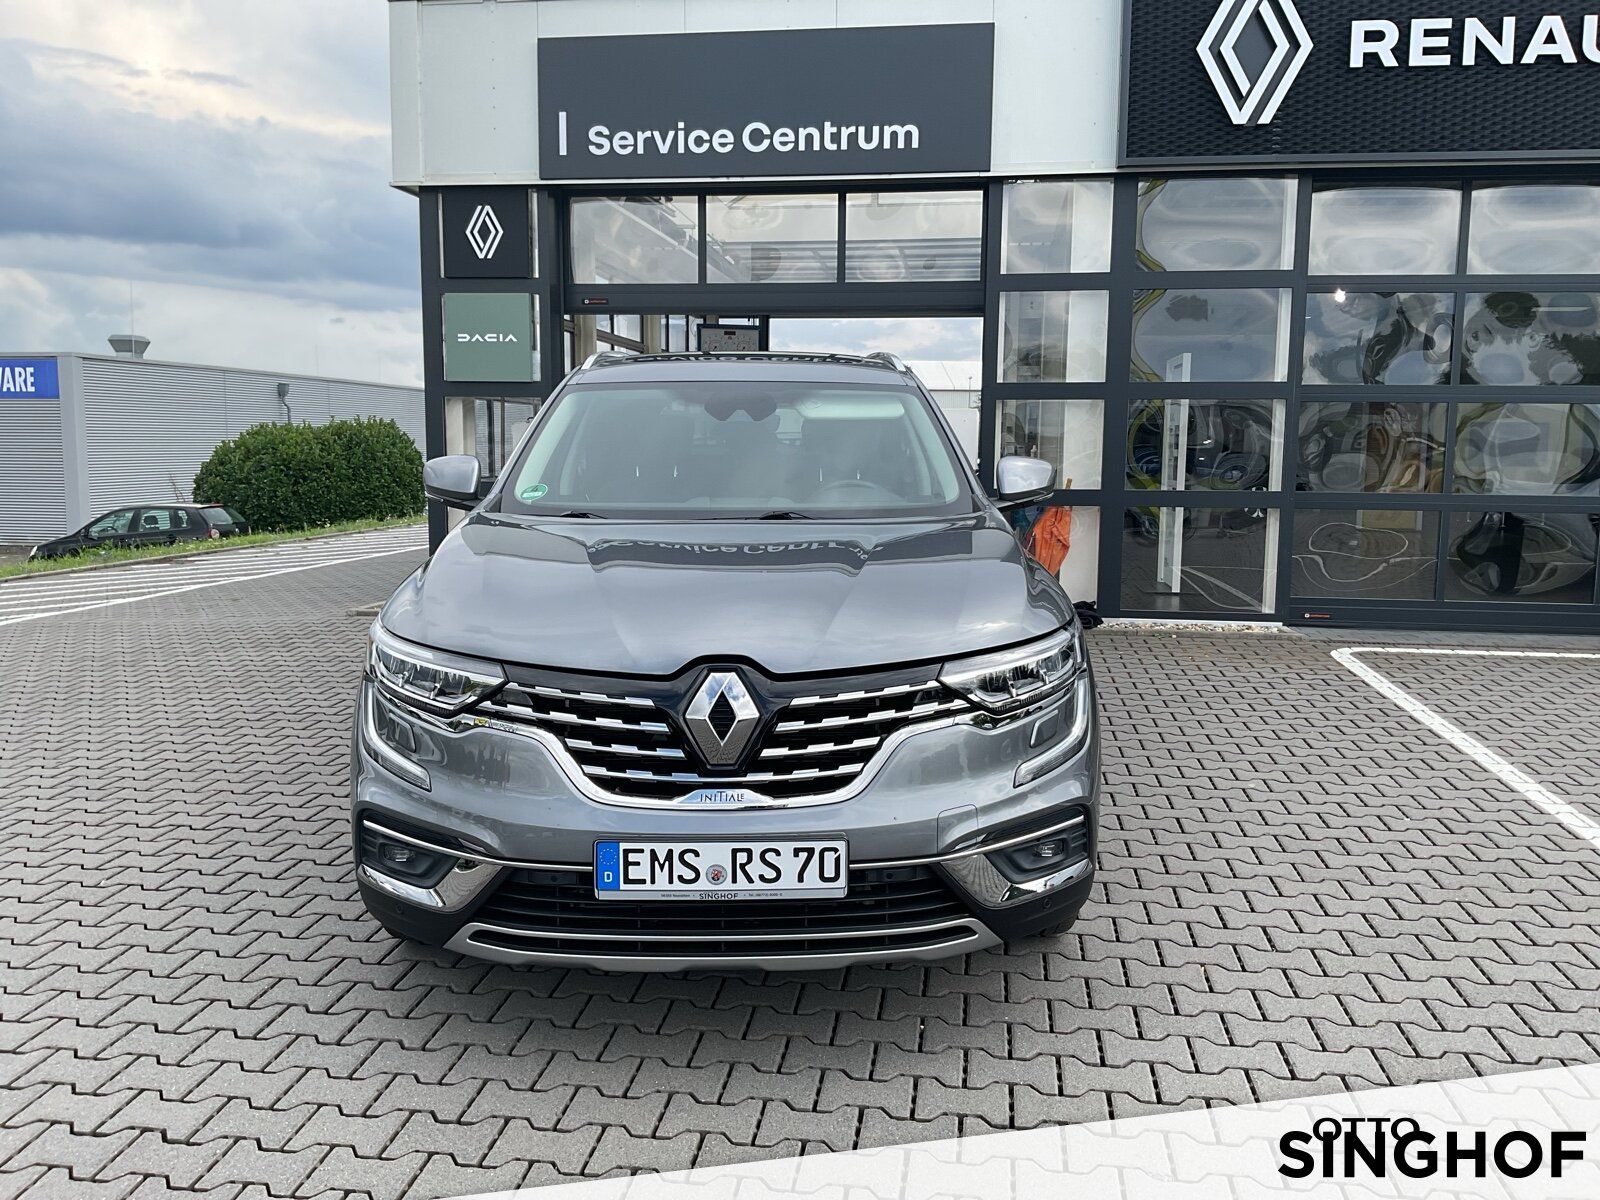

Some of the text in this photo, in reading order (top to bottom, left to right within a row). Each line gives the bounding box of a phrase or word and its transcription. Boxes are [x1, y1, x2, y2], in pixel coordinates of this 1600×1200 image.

[588, 121, 919, 155] Service Centrum
[457, 333, 518, 342] DACIA
[0, 366, 36, 392] ARE
[700, 790, 745, 802] INITIALE
[622, 846, 841, 885] EMS RS 70
[604, 871, 613, 883] D
[699, 892, 739, 900] SINGHOF
